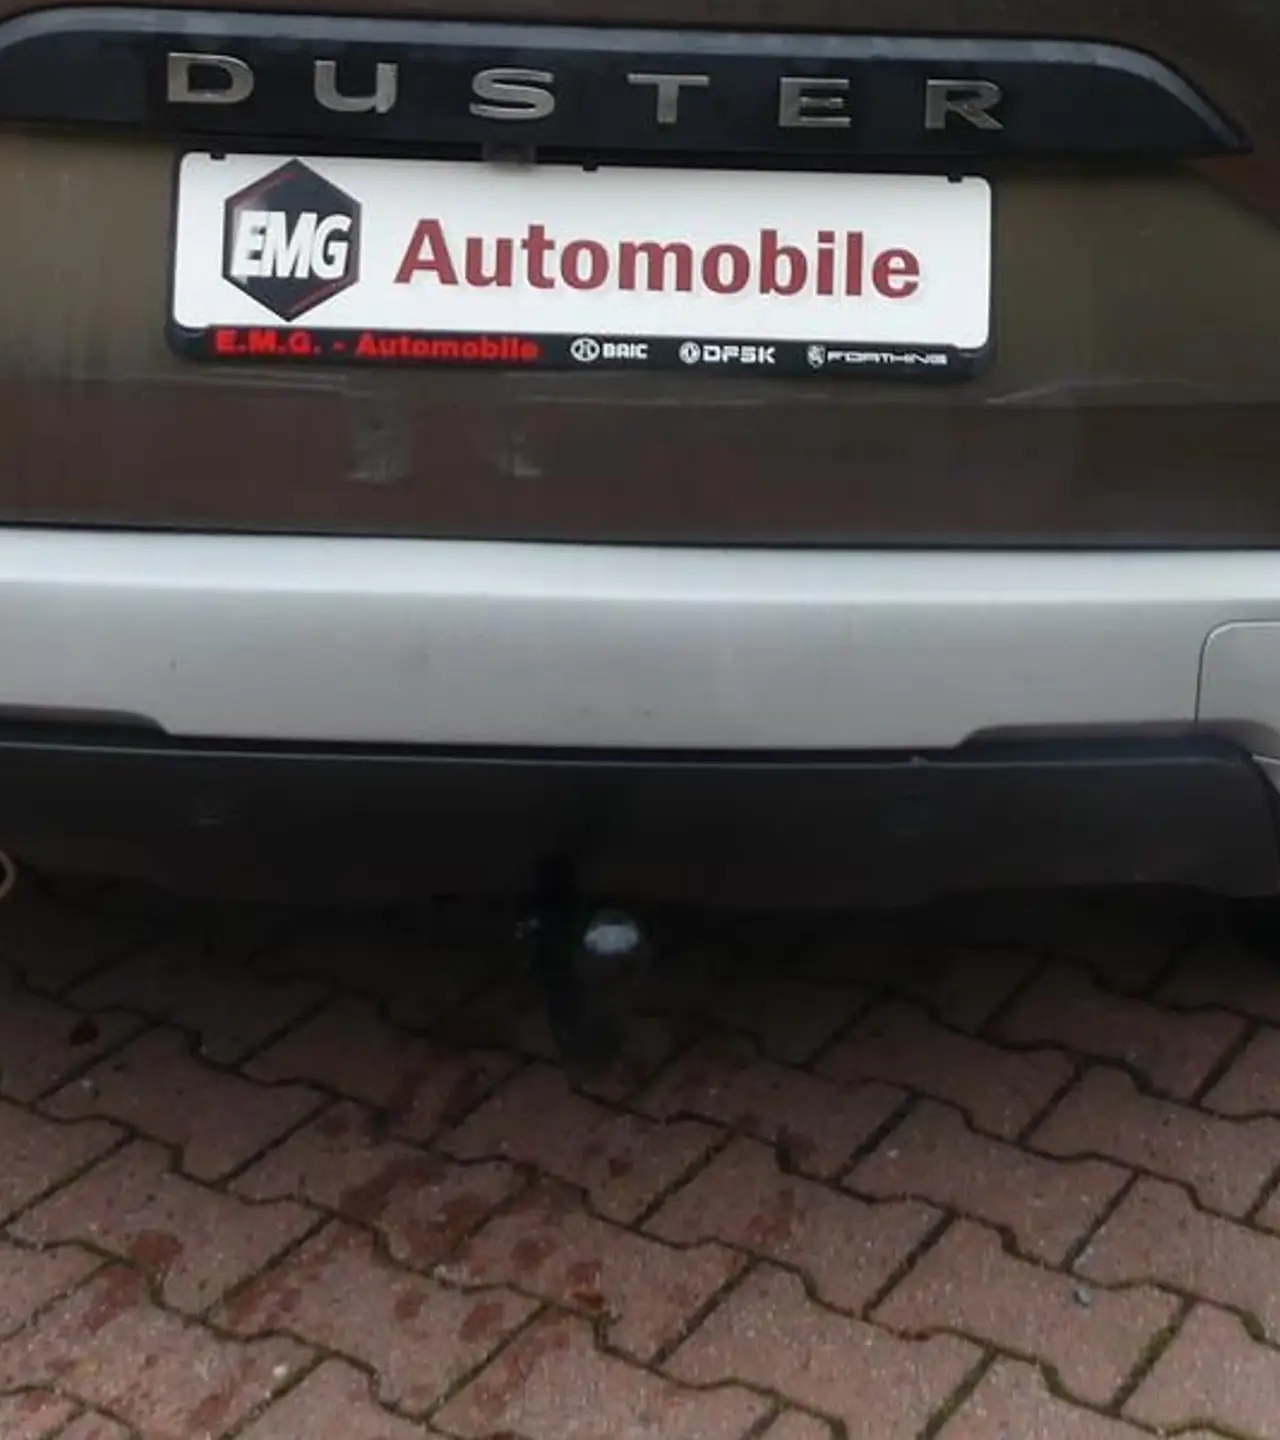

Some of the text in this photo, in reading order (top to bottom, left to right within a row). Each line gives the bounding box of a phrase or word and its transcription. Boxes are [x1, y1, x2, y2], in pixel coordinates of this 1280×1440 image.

[167, 52, 1004, 130] DUSTER
[230, 210, 921, 299] EMG Automobile
[215, 328, 321, 356] E.M.G.
[354, 332, 540, 360] Automobile
